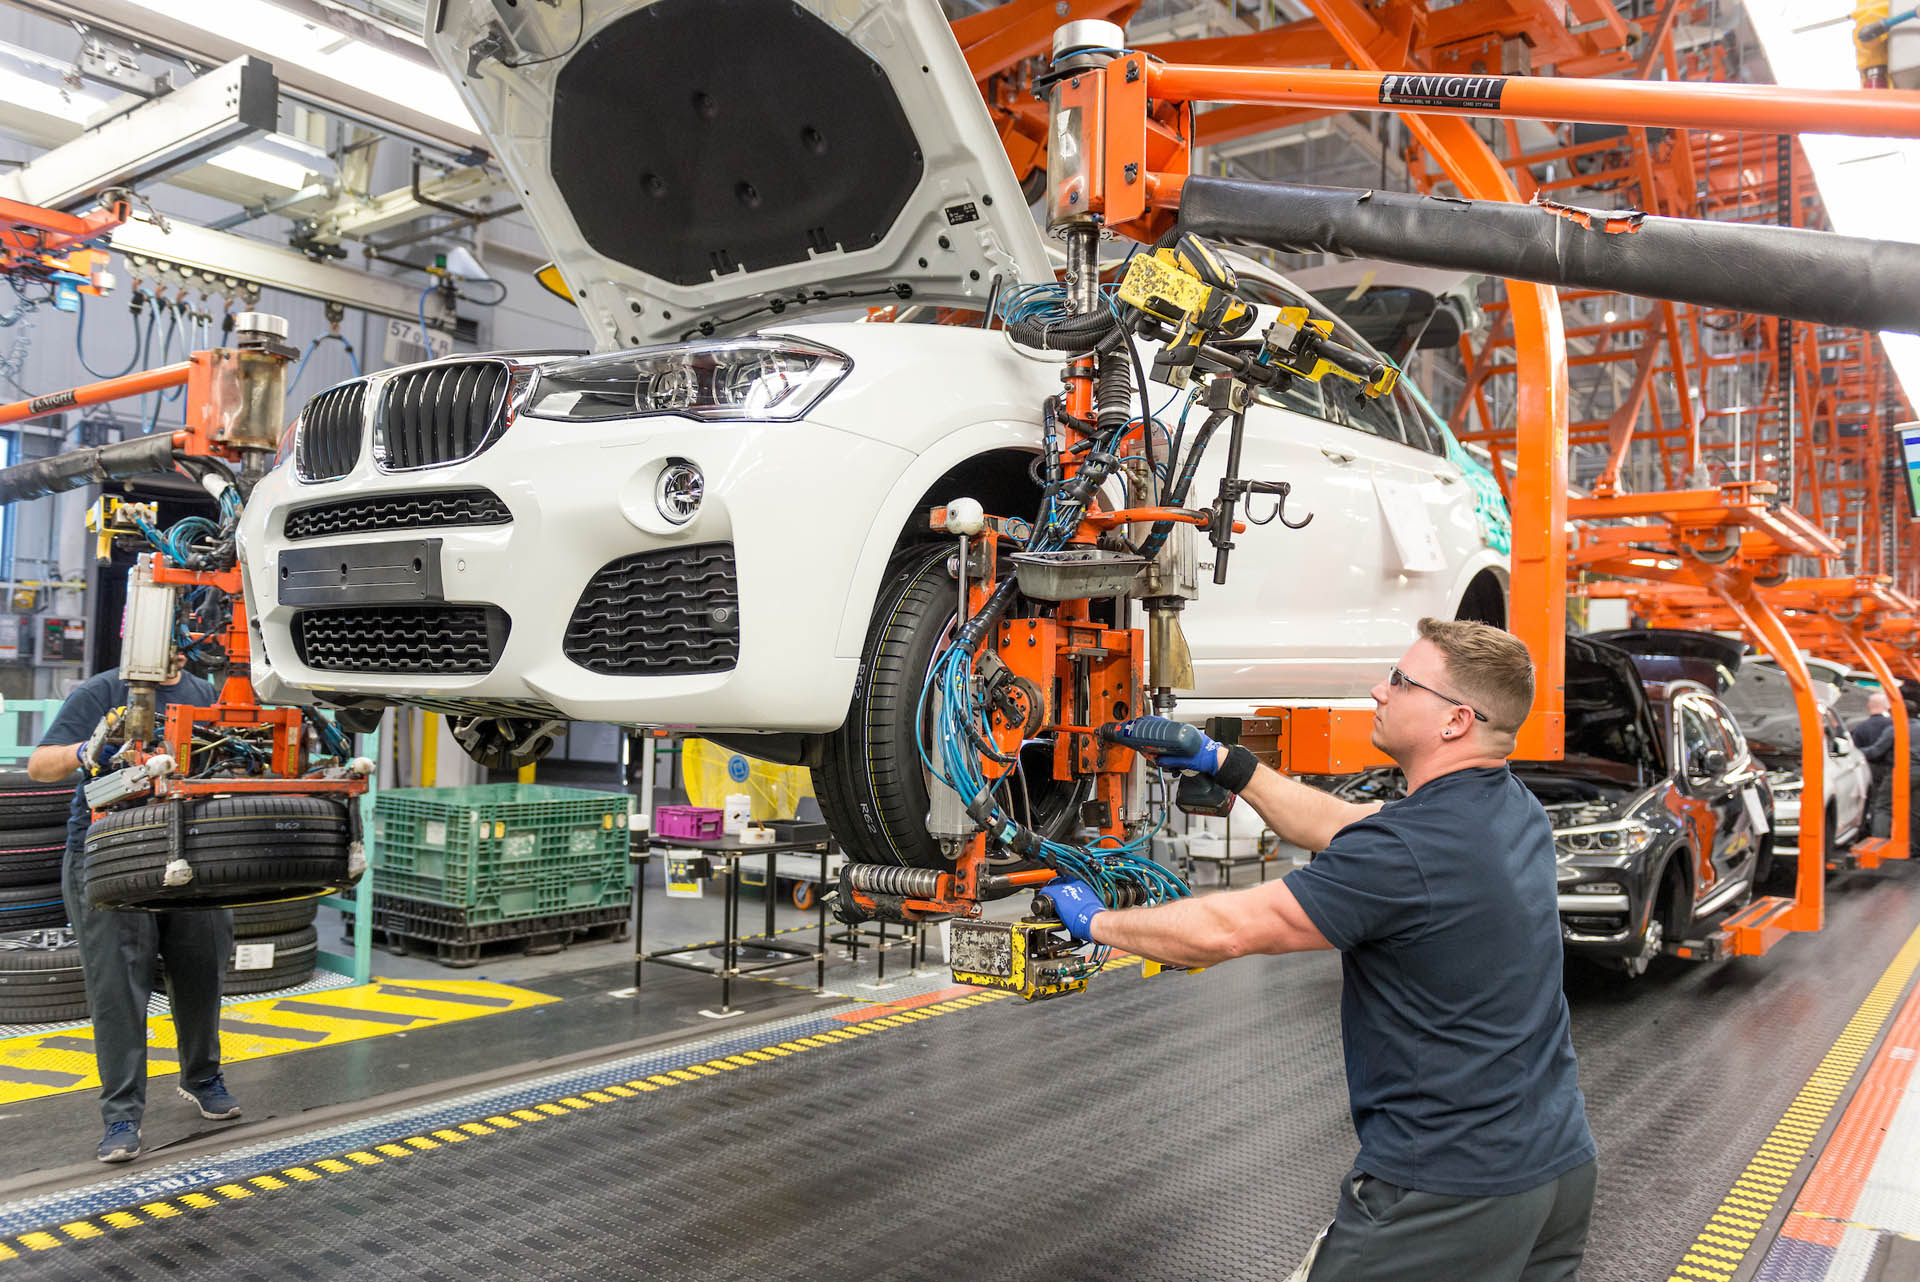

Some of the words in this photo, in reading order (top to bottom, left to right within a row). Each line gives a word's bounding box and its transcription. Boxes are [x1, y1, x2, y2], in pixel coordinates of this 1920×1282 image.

[1399, 75, 1501, 98] KNIGHT
[390, 320, 411, 338] 57
[275, 822, 300, 831] R62
[860, 802, 878, 833] R62
